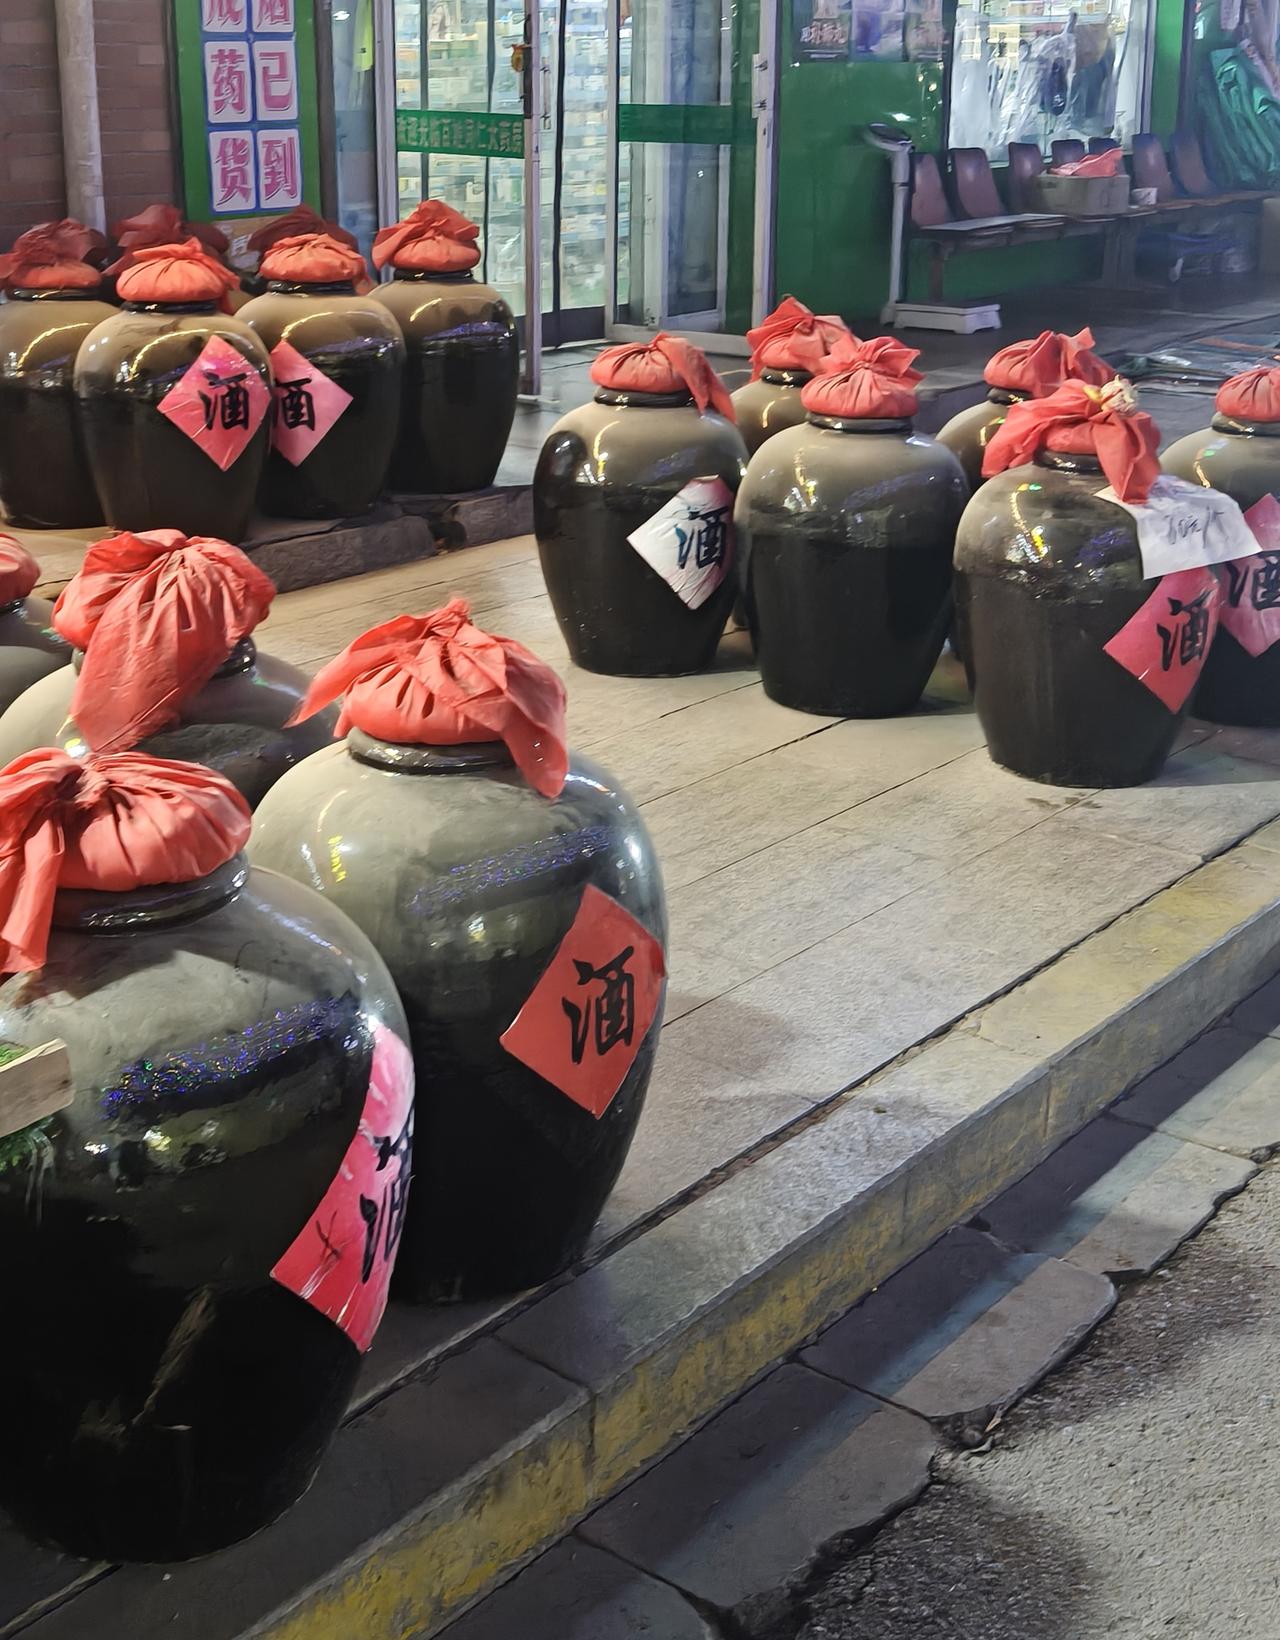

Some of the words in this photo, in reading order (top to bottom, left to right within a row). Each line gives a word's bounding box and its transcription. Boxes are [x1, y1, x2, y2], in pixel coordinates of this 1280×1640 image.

[197, 371, 251, 431] 酒
[674, 504, 730, 570] 酒
[1155, 588, 1211, 672] 酒
[561, 945, 635, 1065] 酒
